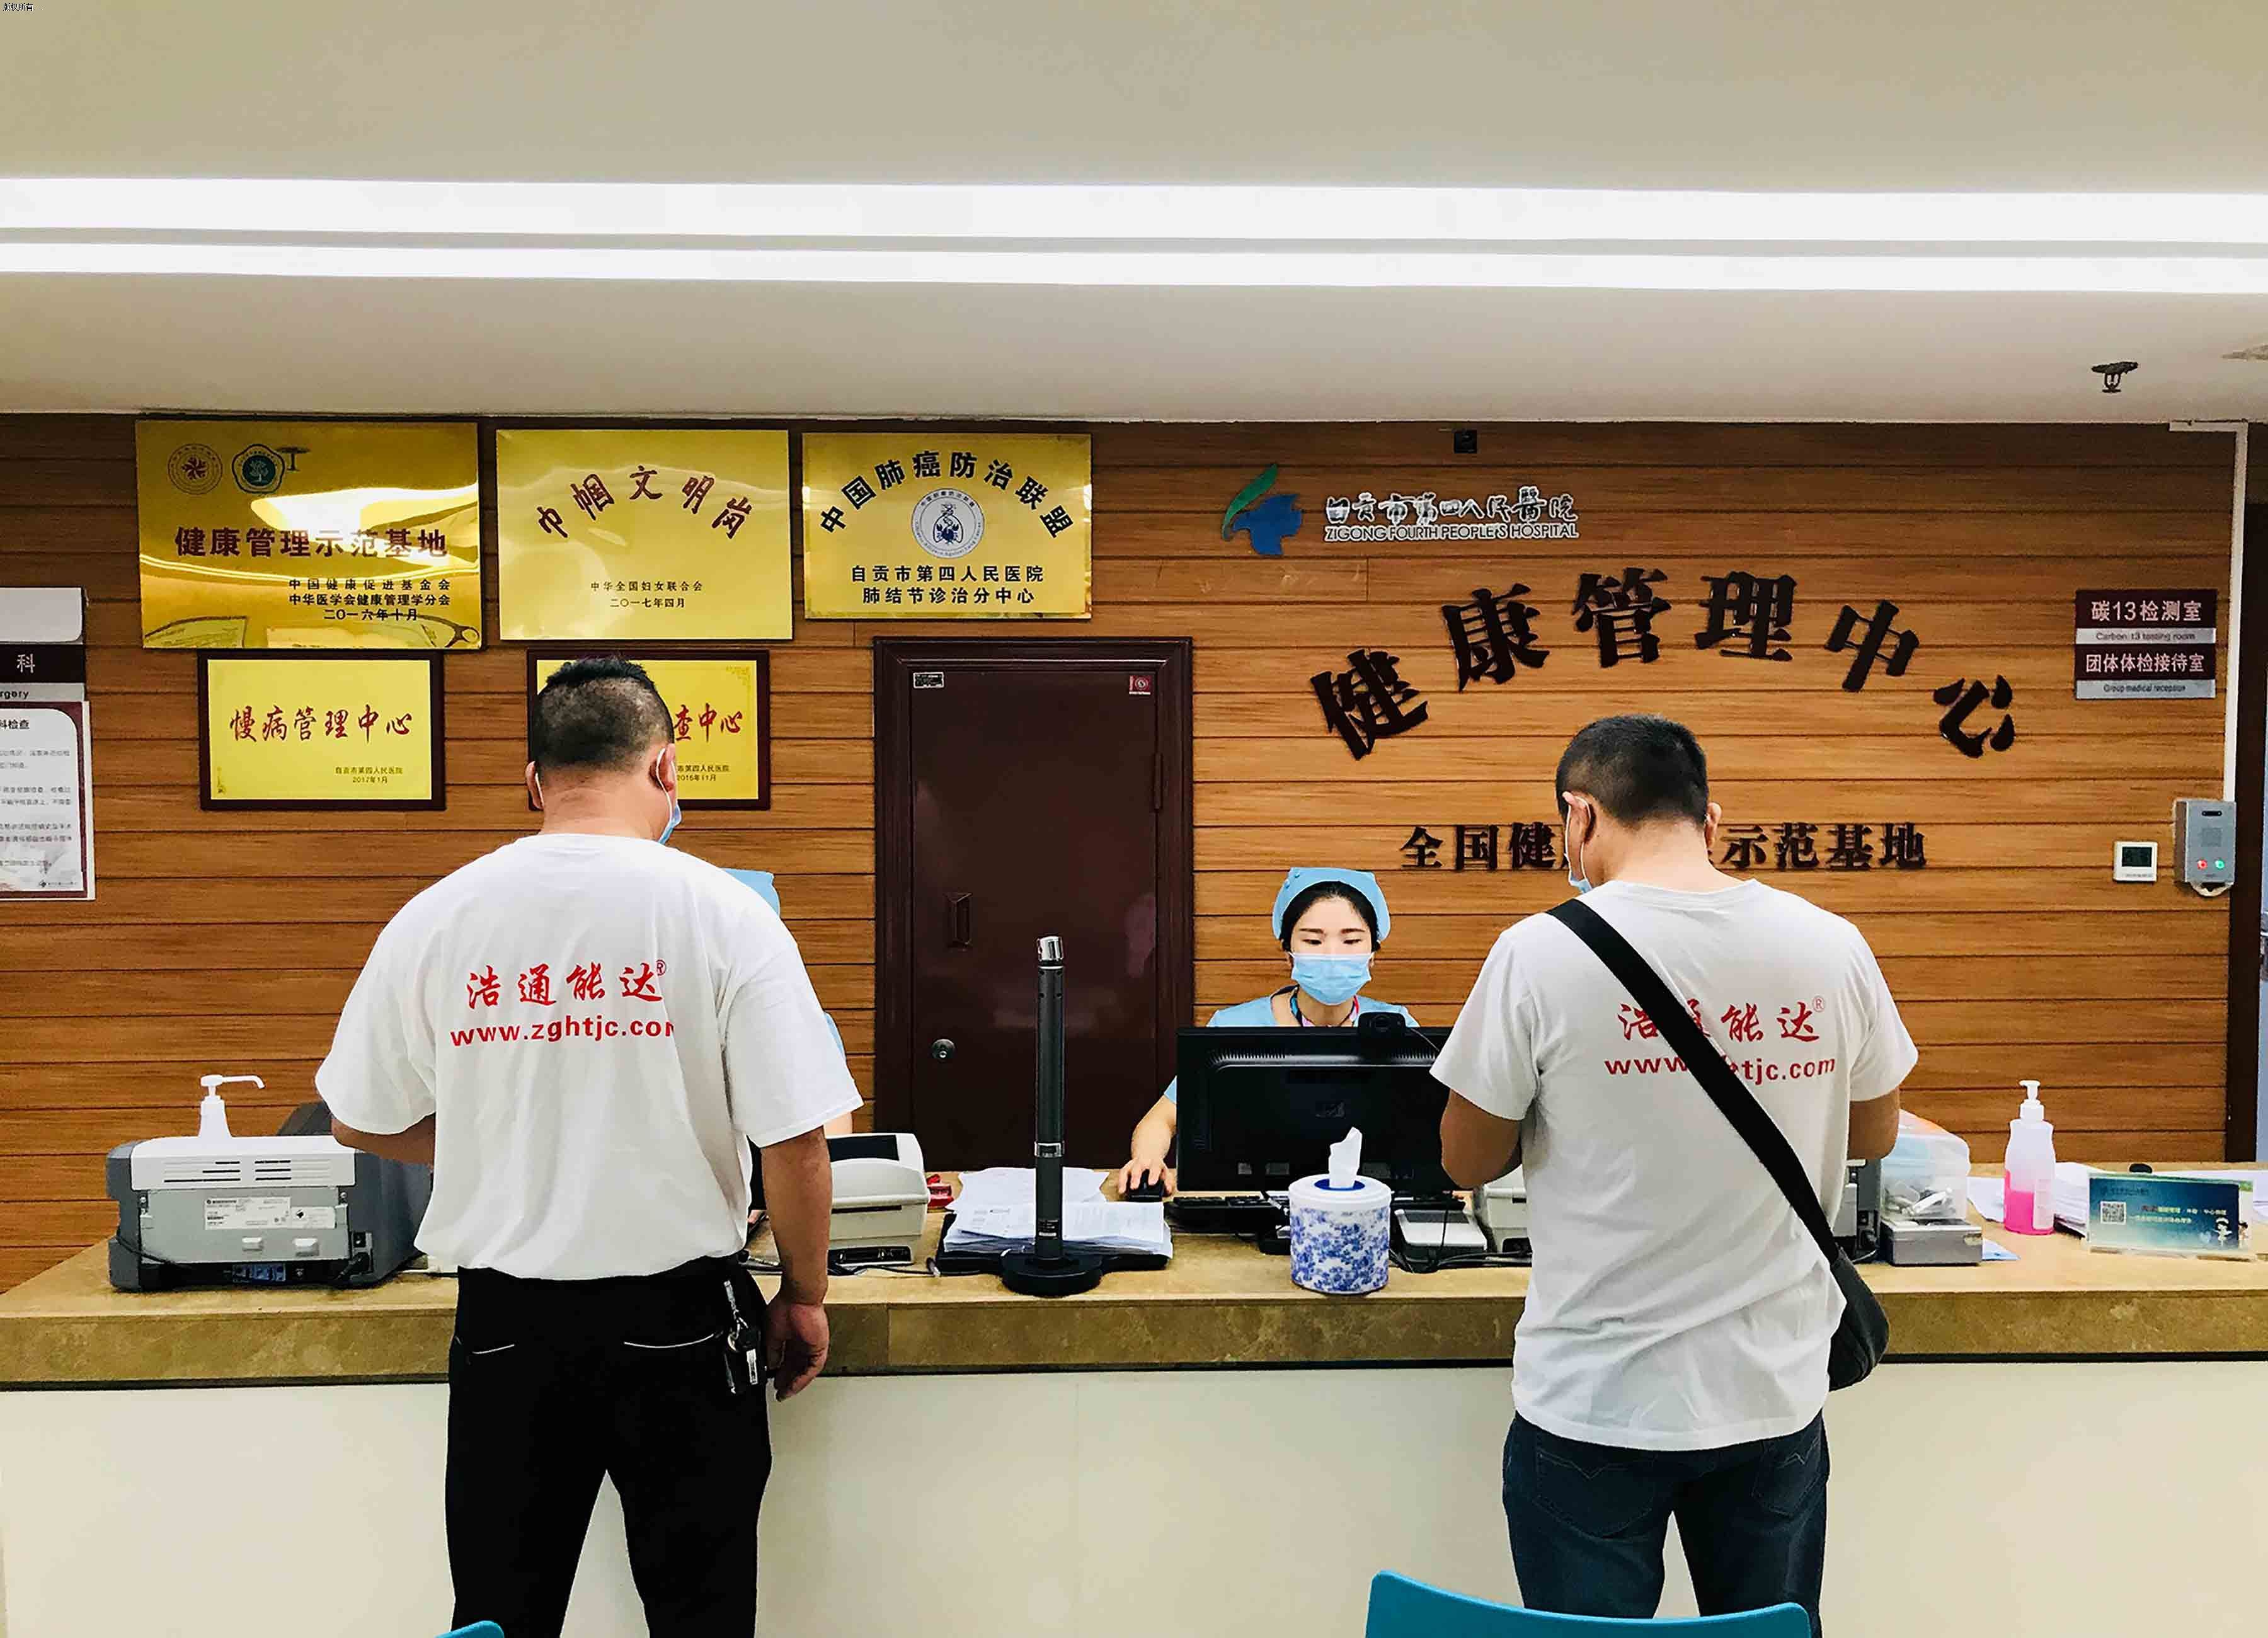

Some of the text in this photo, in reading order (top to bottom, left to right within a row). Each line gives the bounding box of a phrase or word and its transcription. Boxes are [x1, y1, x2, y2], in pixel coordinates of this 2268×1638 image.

[536, 465, 754, 539] 巾帼文明岗
[820, 450, 1074, 538] 中国肺癌防治联盟
[175, 525, 449, 558] 健康管理示范基地
[1325, 527, 1386, 541] ZIGONG
[1389, 525, 1439, 540] FOURTH
[1511, 524, 1579, 539] HOSPITAL
[851, 564, 1045, 583] 自贡市第四人民医院
[289, 578, 451, 591] 中国健康促进基金会
[590, 581, 704, 592] 中华全国妇女联合会
[289, 593, 451, 606] 中华医学会健康管理学分会
[862, 587, 1036, 604] 肺结节诊治分中心
[2090, 600, 2202, 622] 碳13检测室
[16, 653, 36, 673] 科
[1310, 567, 2017, 761] 健康管理中心
[2086, 653, 2204, 673] 团体体检接待室
[229, 704, 413, 743] 慢病管理中心
[467, 961, 663, 1009] 浩通能达
